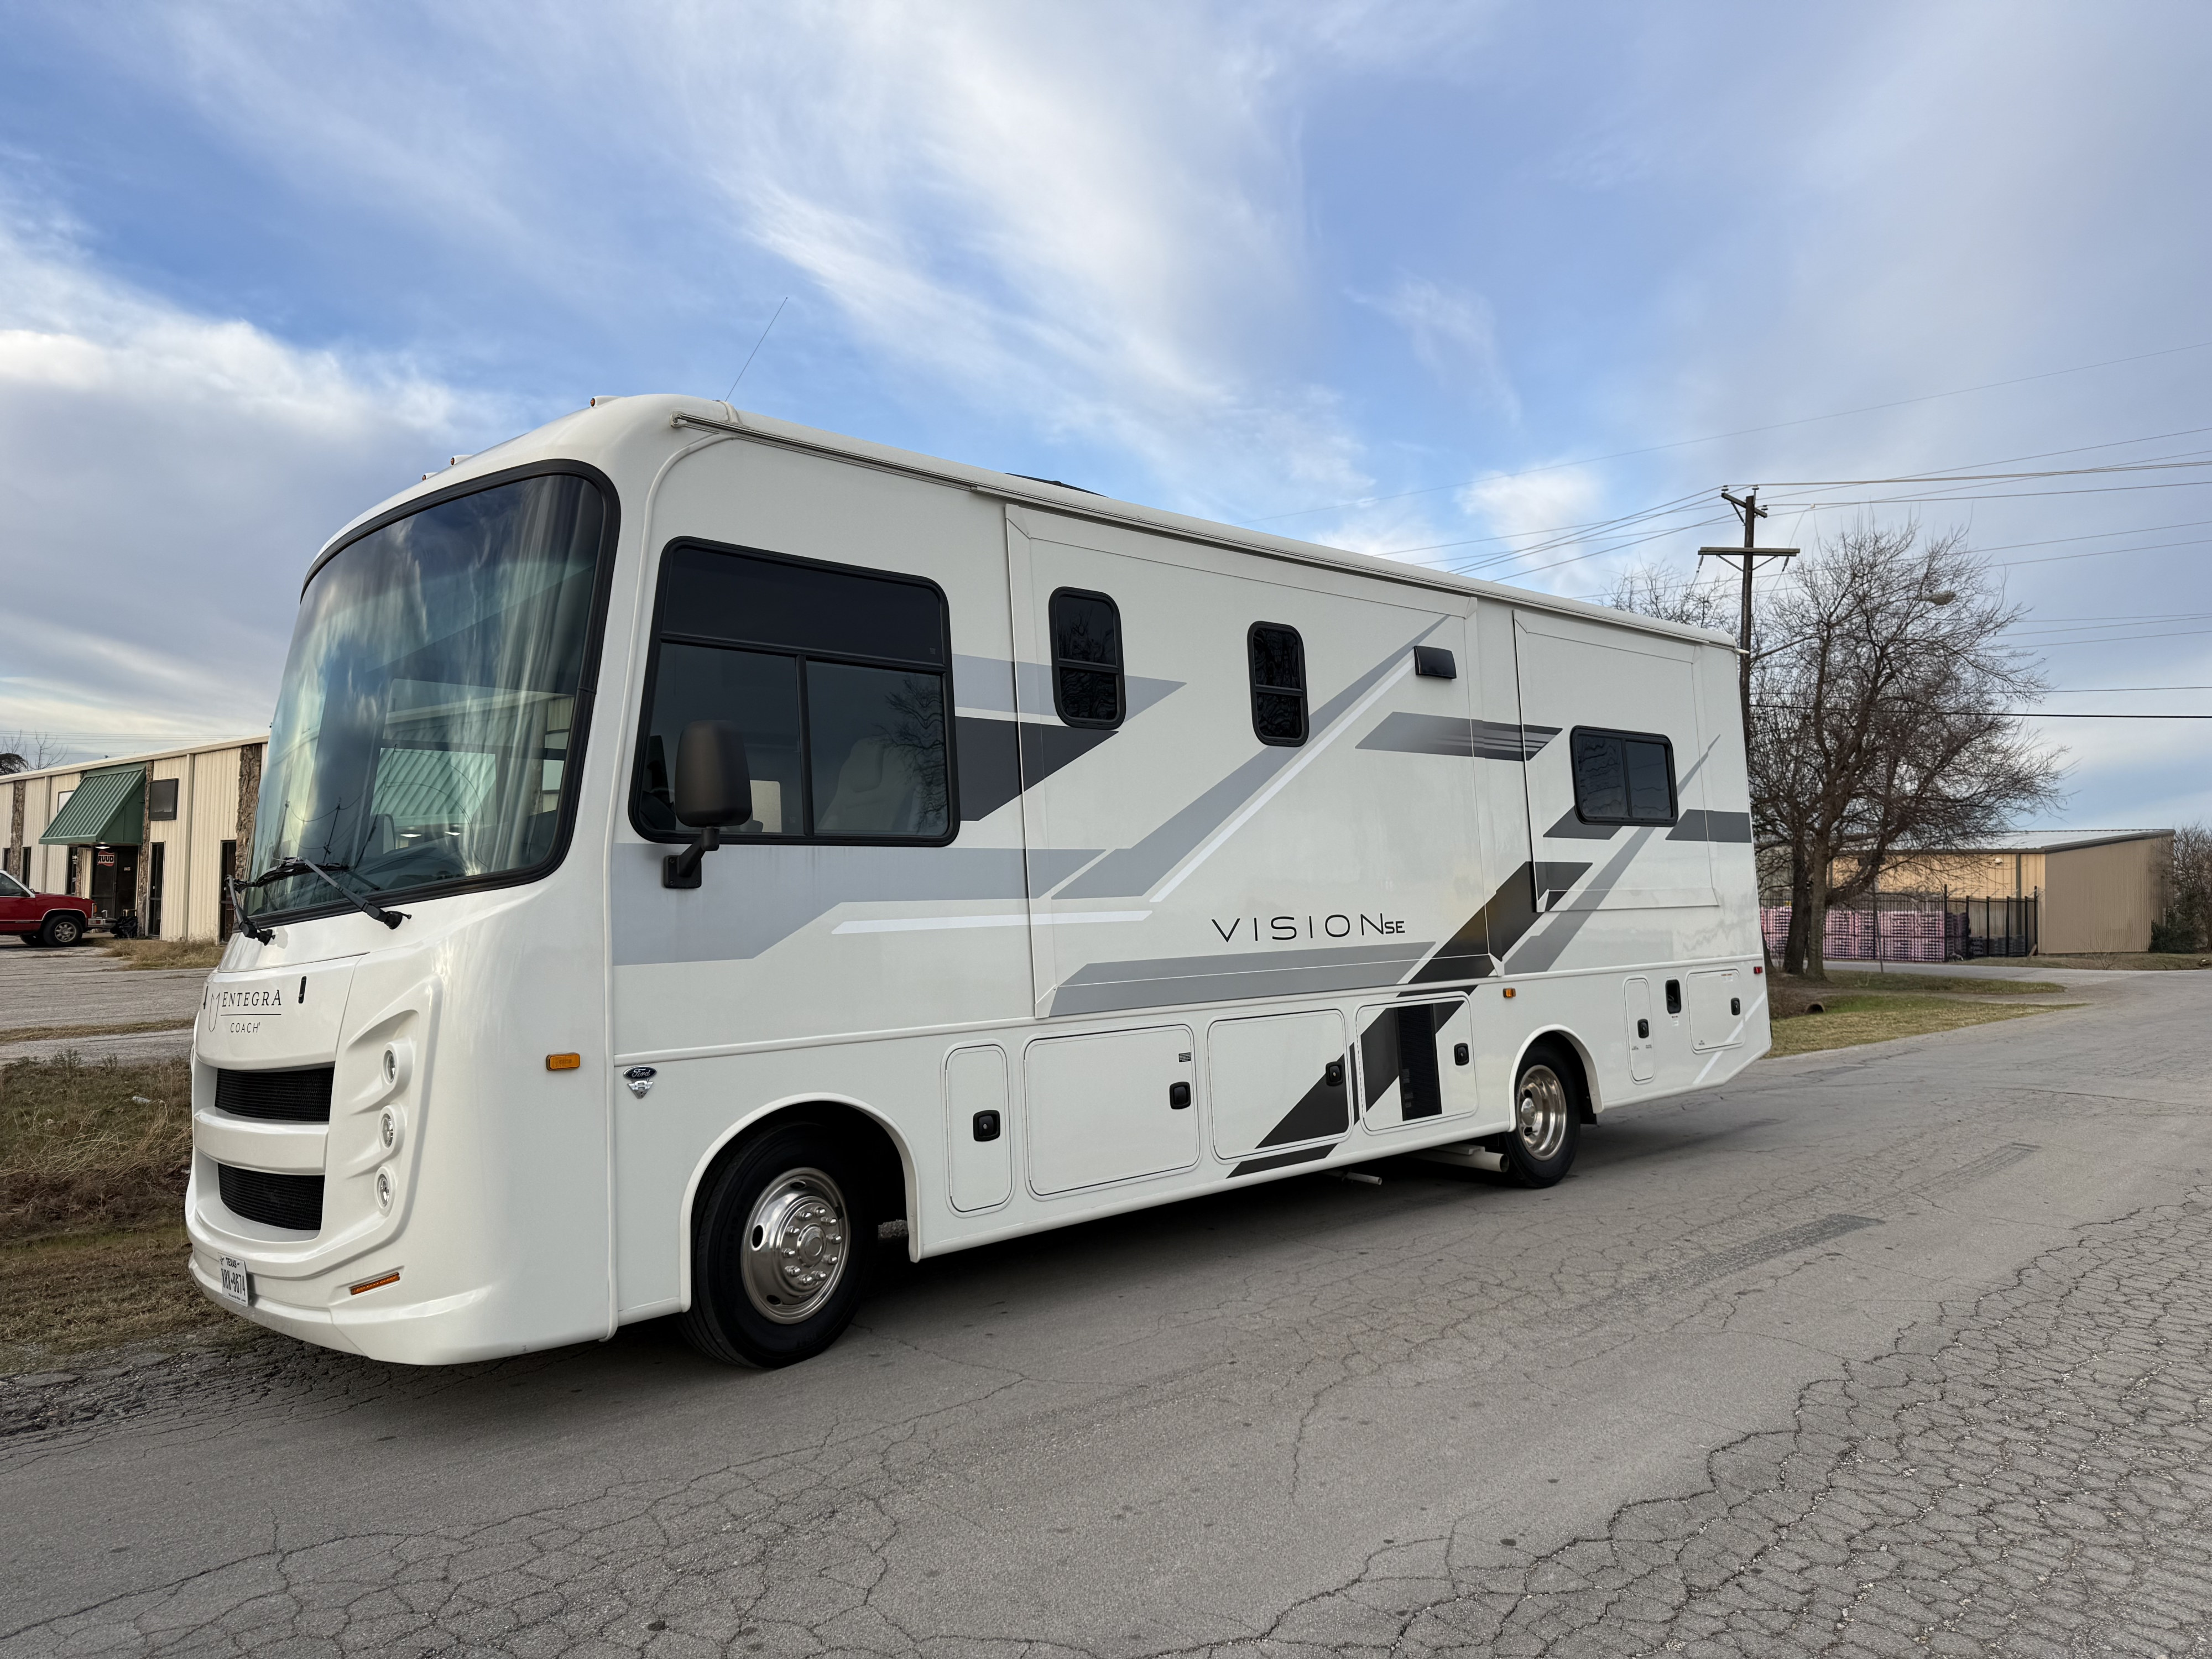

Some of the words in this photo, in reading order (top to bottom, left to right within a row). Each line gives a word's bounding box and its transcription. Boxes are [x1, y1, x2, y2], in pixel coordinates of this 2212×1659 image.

[1211, 913, 1384, 943] VISION
[1384, 921, 1405, 934] SE
[222, 989, 281, 1007] ENTEGRA
[230, 1022, 259, 1033] COACH
[632, 1068, 651, 1078] Ford
[226, 1257, 237, 1269] TEXAS
